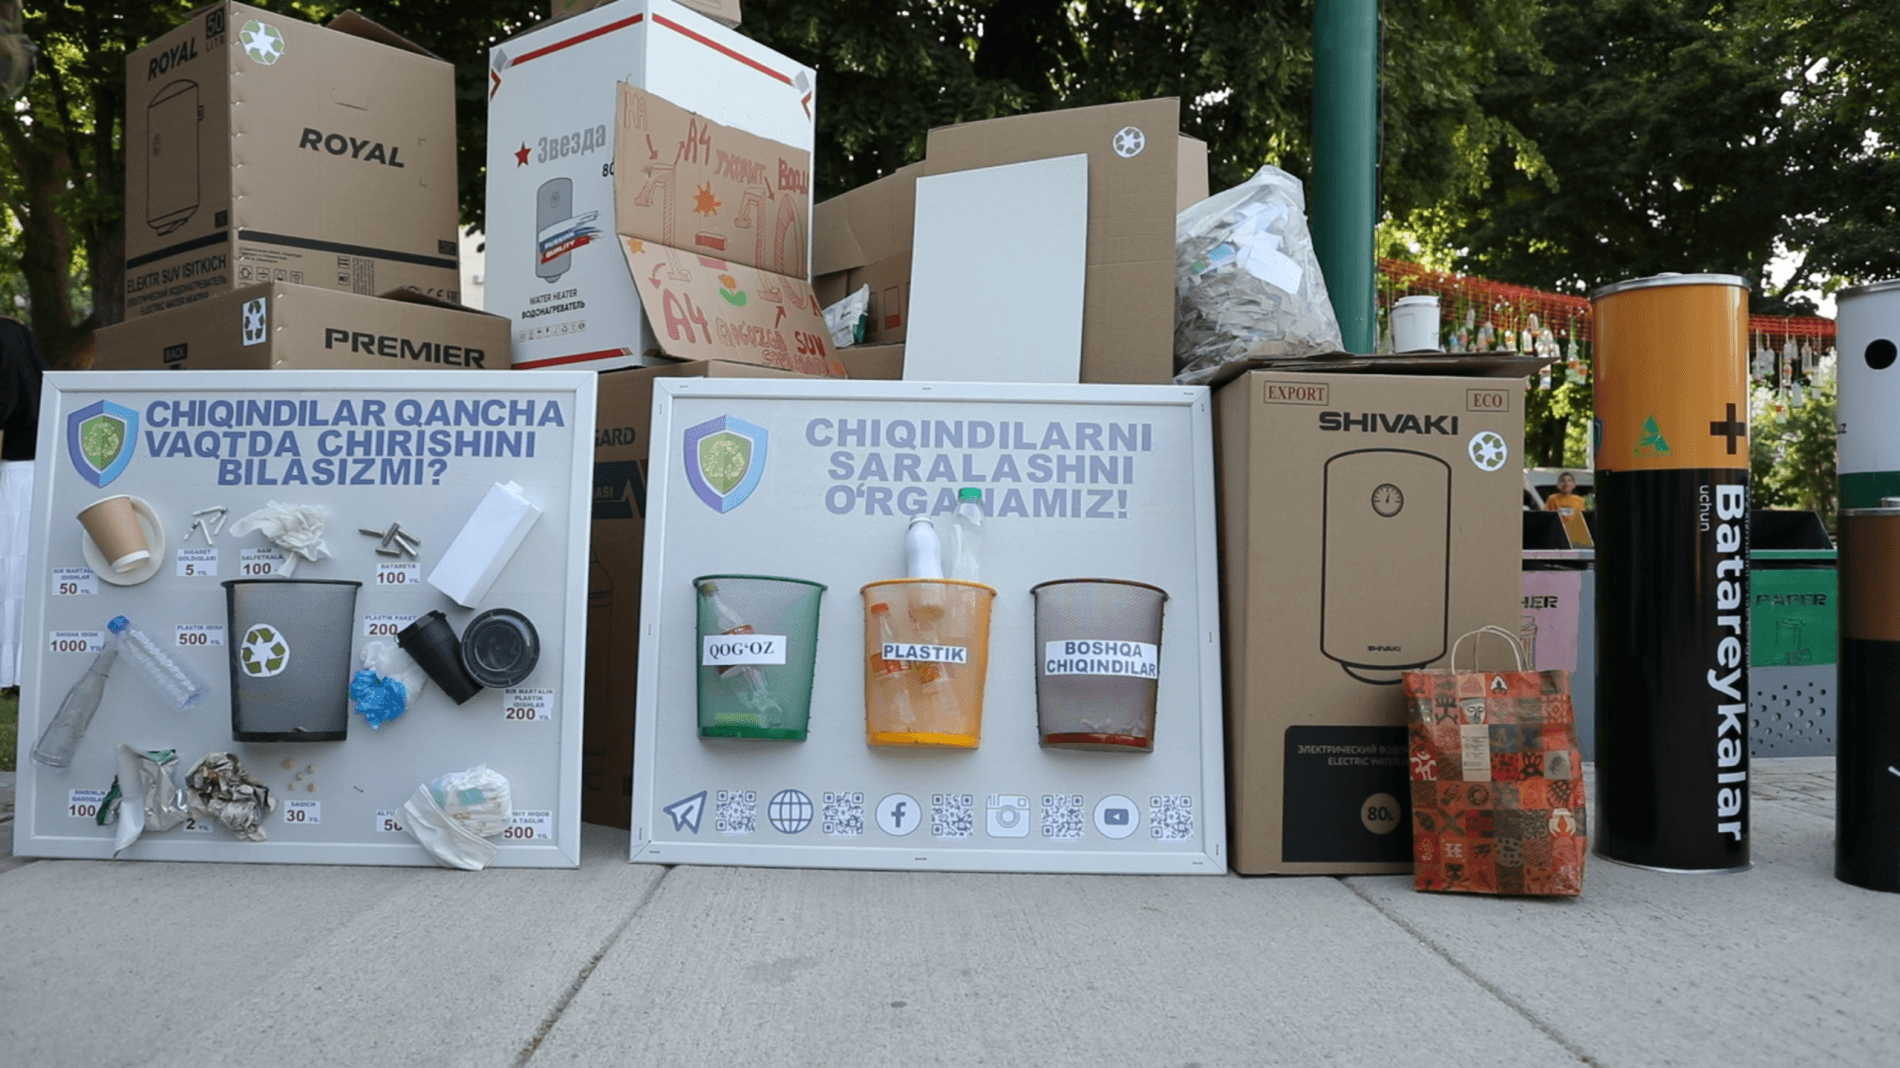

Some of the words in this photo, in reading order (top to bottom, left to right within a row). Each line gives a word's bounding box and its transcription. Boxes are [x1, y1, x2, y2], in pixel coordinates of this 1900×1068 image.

[206, 11, 223, 36] 50
[147, 37, 198, 81] ROYAL
[299, 127, 405, 168] ROYAL
[537, 125, 606, 163] Звезда
[127, 271, 160, 294] ELEKTR
[162, 264, 181, 284] SUV
[182, 254, 227, 278] ISITKICH
[529, 293, 552, 306] WATER
[552, 287, 578, 301] HEATER
[521, 300, 586, 319] ВОДОНАГРЕВАТЕЛЬ
[325, 328, 485, 369] PREMIER
[1268, 386, 1325, 401] EXPORT
[1473, 394, 1503, 408] ECO
[145, 399, 386, 429] CHIQINDILAR
[395, 398, 565, 428] QANCHA
[1318, 411, 1459, 436] SHIVAKI
[805, 417, 1152, 451] CHIQINDILARNI
[144, 429, 302, 460] VAQTDA
[317, 429, 536, 458] CHIRISHINI
[217, 458, 448, 486] BILASIZMI?
[828, 451, 1134, 484] SARALASHNI
[1699, 484, 1713, 532] uchun
[186, 563, 195, 576] 5
[244, 562, 272, 575] 100
[378, 572, 406, 584] 100
[60, 583, 78, 595] 50
[1756, 593, 1828, 606] PAPER
[179, 633, 207, 645] 500
[369, 623, 399, 636] 200
[51, 640, 88, 652] 1000
[883, 645, 966, 662] PLASTIK
[1065, 641, 1143, 658] BOSHQA
[1046, 658, 1157, 678] CHIQINDILAR
[1707, 484, 1746, 842] Batareykalar
[506, 707, 536, 720] 200
[1297, 744, 1378, 755] ЭЛЕКТРИЧЕСКИЙ
[1327, 756, 1369, 766] ELECTRIC
[69, 804, 96, 817] 100
[286, 810, 306, 822] 30
[186, 818, 196, 830] 2
[503, 826, 534, 839] 500
